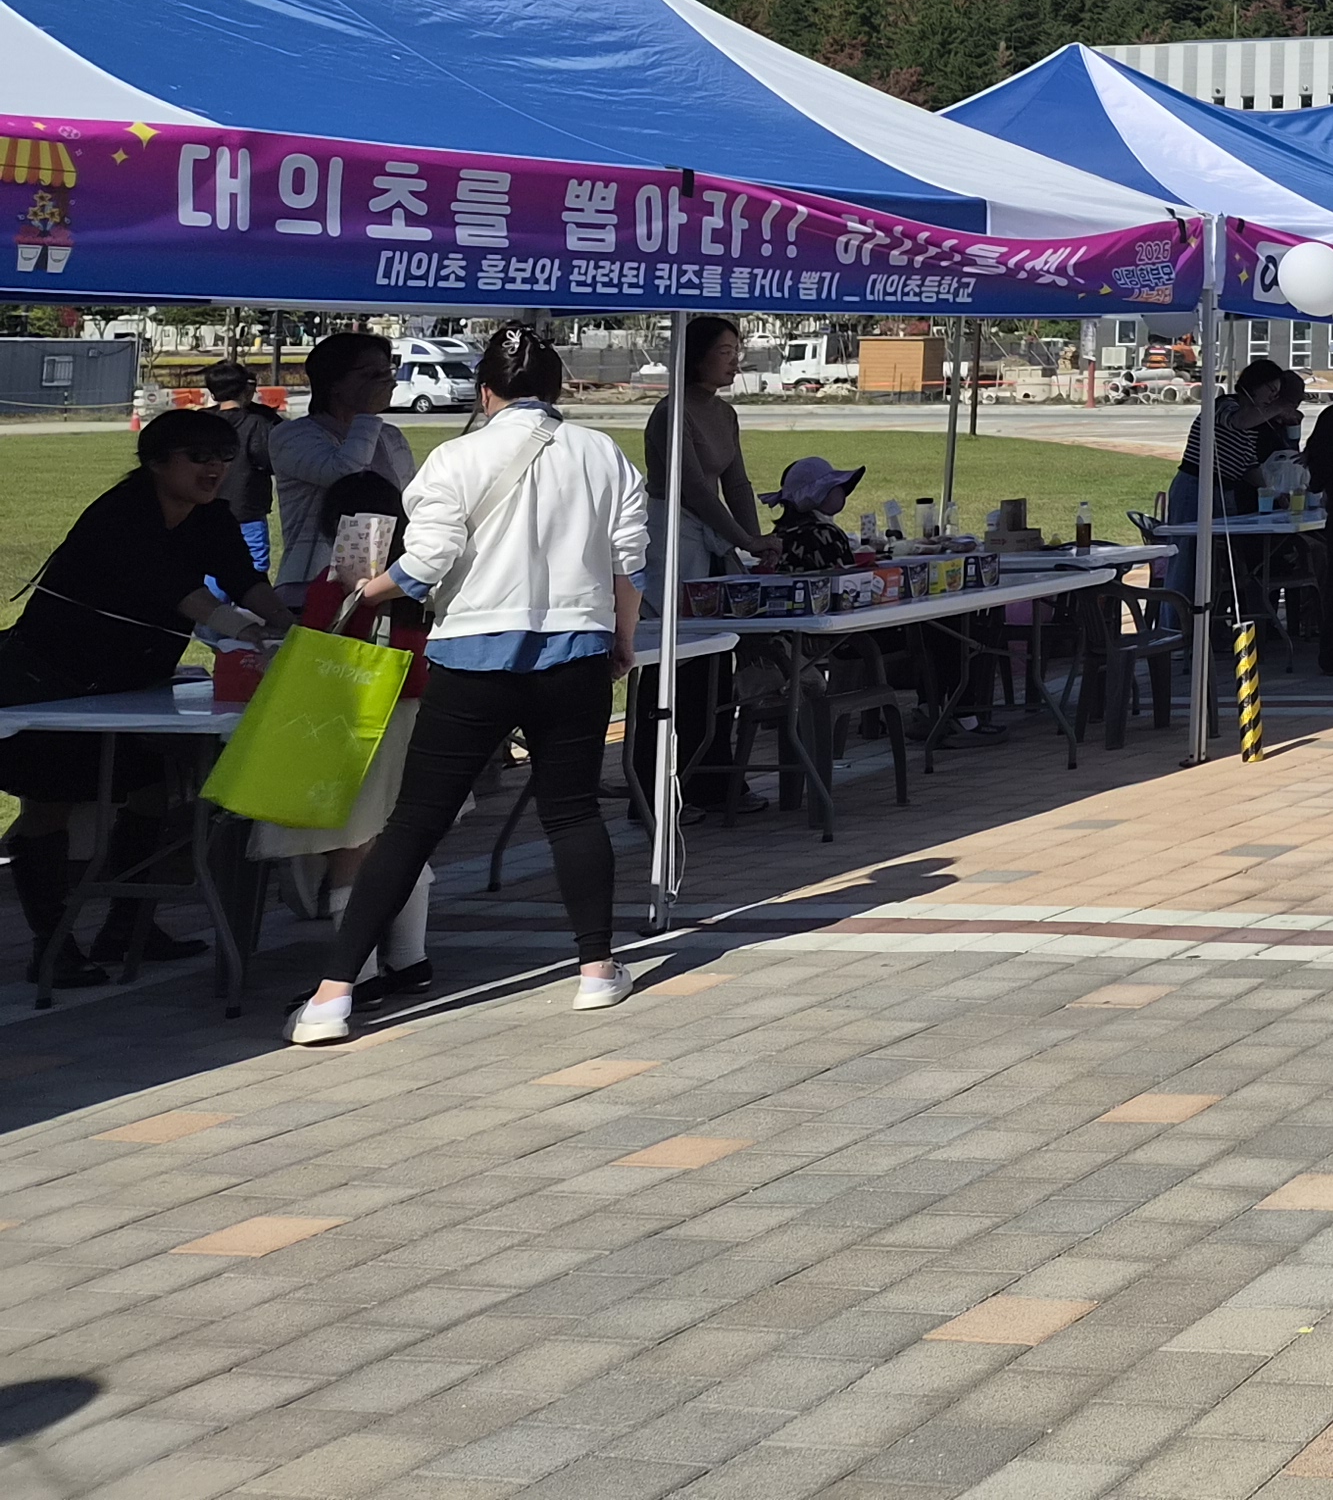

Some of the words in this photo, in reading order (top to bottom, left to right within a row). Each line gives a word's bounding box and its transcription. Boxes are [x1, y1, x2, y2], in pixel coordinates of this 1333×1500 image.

[177, 143, 512, 248] 대의초를
[561, 178, 808, 258] 뽑아라!!
[375, 250, 467, 288] 대의초
[476, 255, 561, 291] 홍보와
[568, 259, 646, 294] 관련된
[653, 262, 723, 297] 퀴즈를
[729, 267, 793, 299] 풀거나
[798, 271, 841, 301] 뽑기
[865, 274, 977, 303] 대의초등학교
[1134, 239, 1172, 265] 2026
